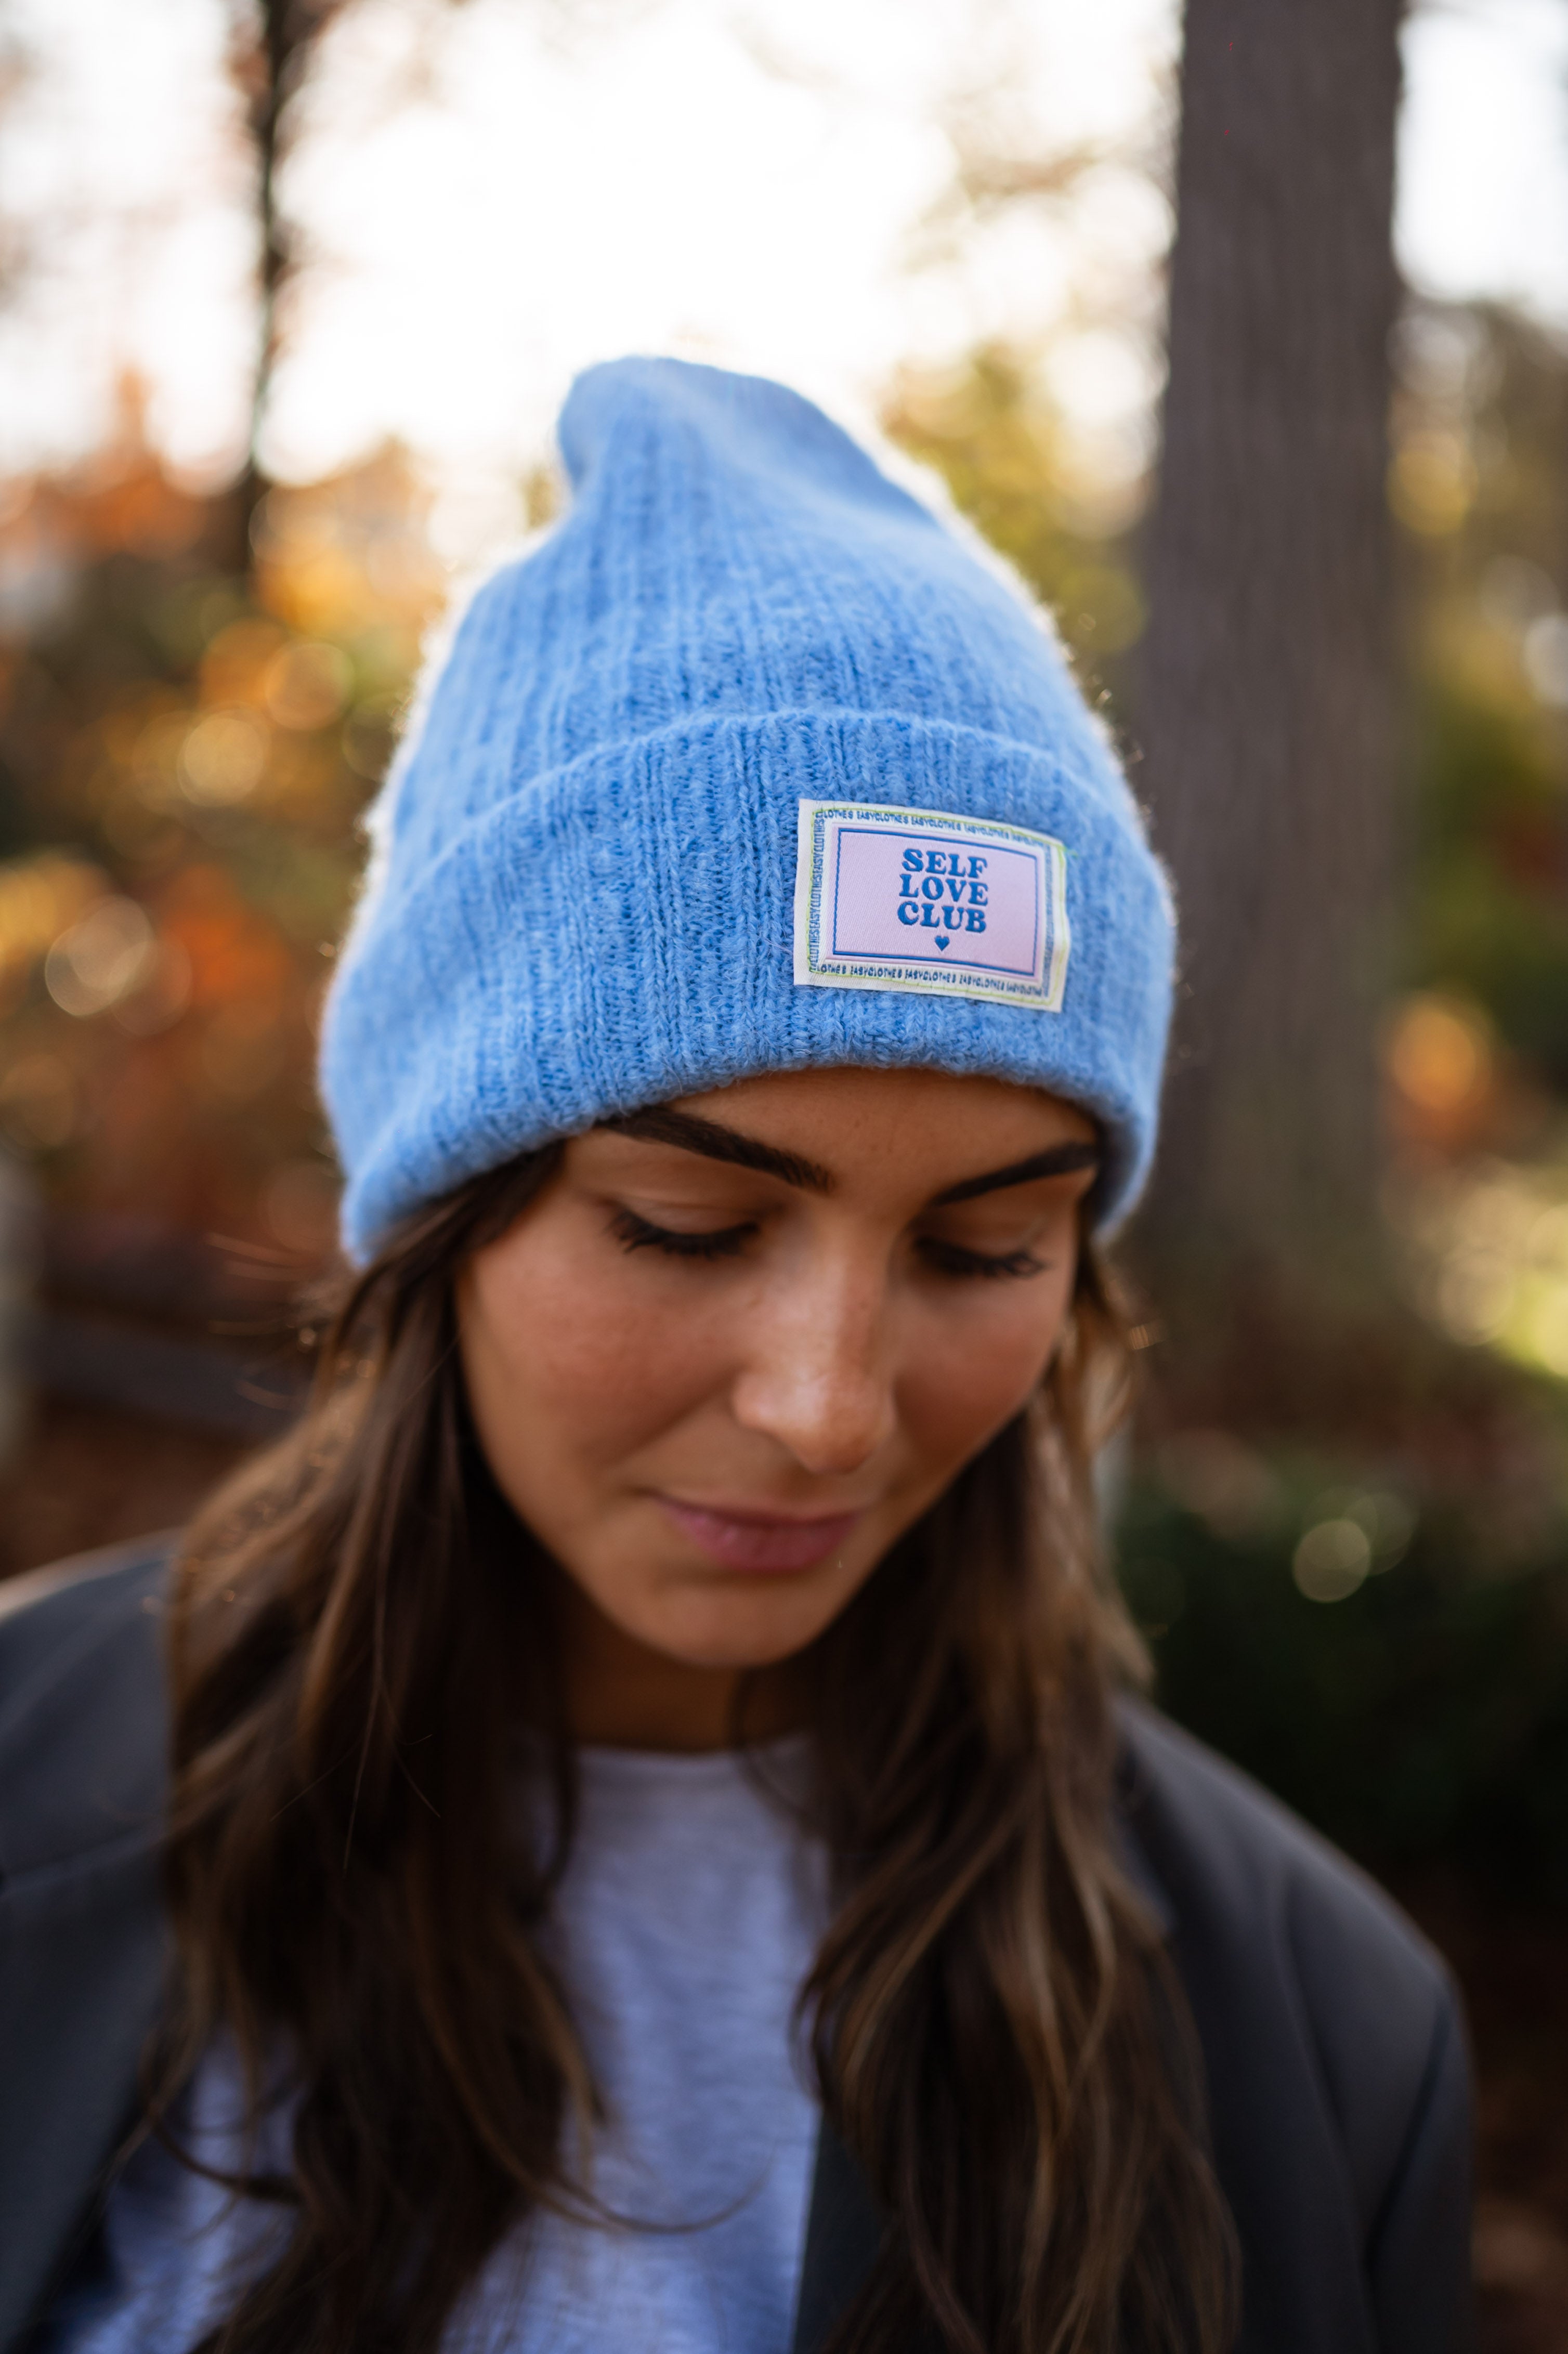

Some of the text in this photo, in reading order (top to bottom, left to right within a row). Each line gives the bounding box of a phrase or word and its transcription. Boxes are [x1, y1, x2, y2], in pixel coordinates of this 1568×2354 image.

[901, 848, 988, 878] SELF
[899, 874, 988, 906] LOVE
[897, 901, 987, 933] CLUB
